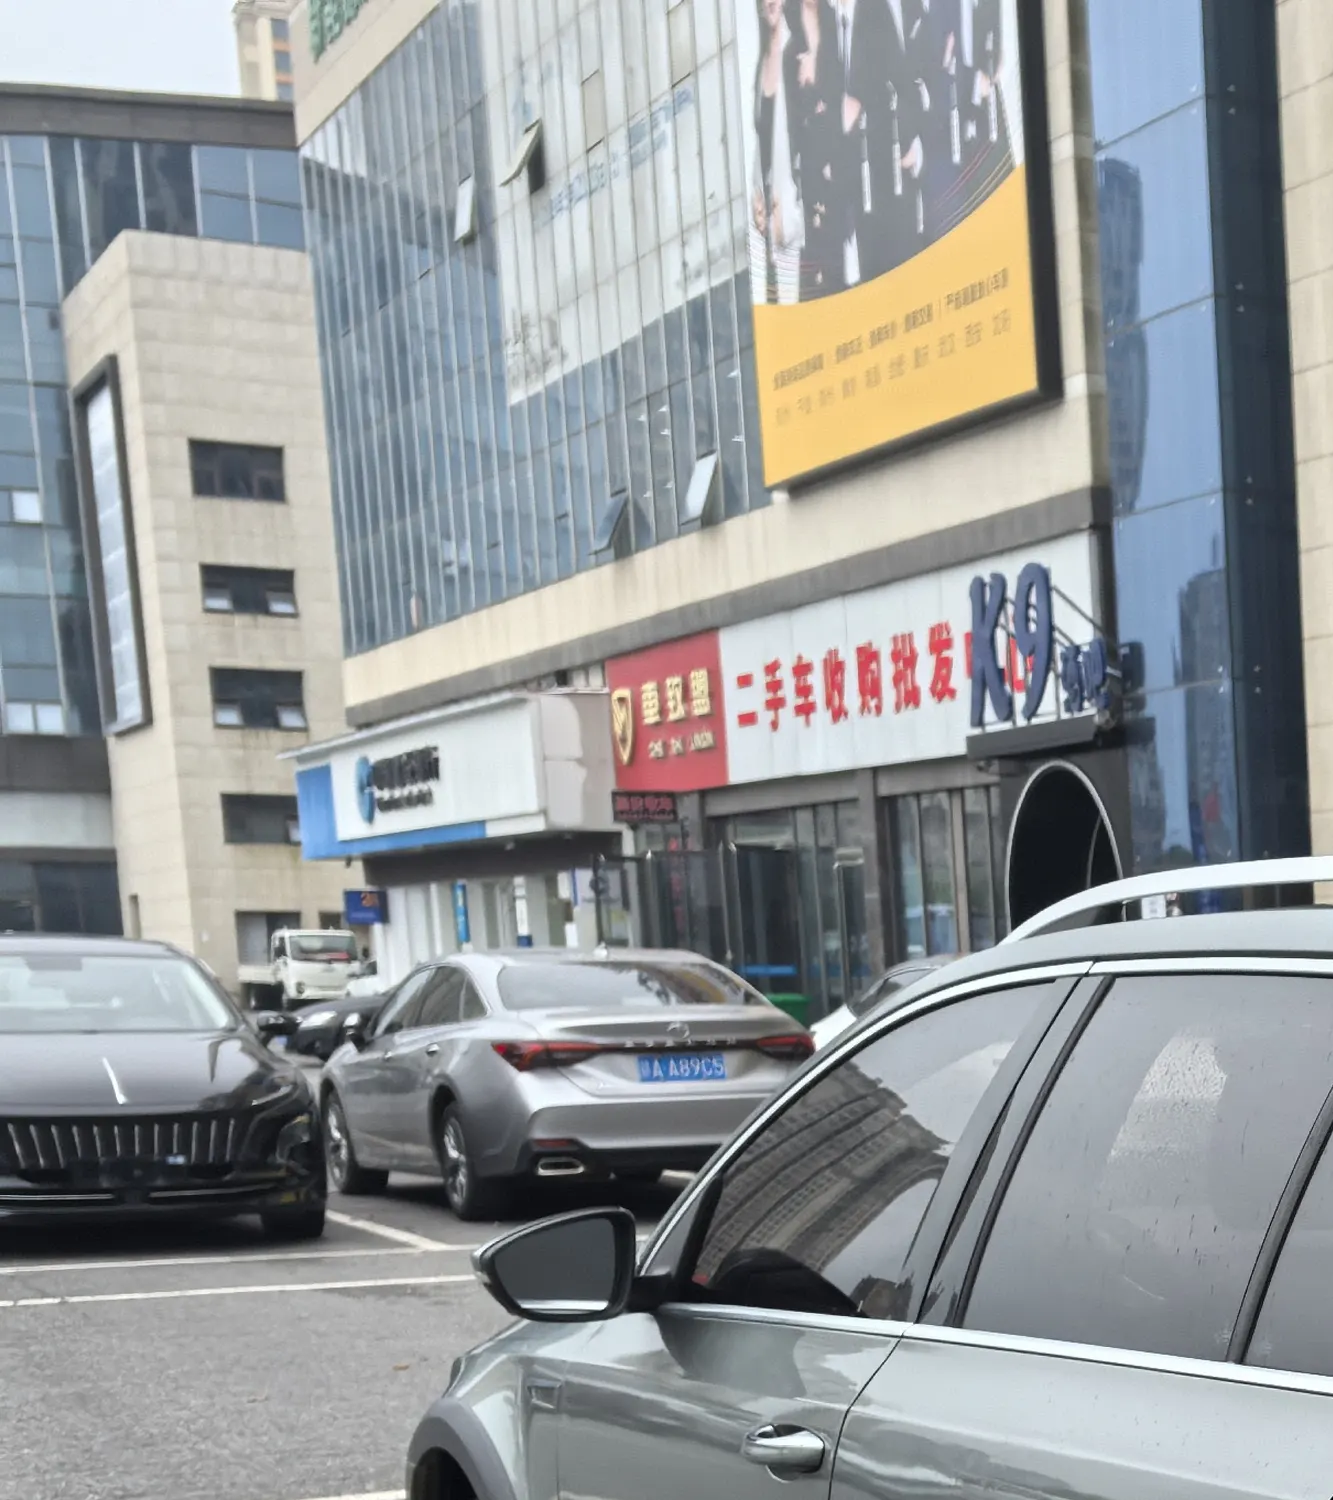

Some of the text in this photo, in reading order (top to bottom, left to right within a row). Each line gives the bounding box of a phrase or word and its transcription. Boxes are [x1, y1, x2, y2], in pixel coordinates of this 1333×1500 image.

[735, 620, 1035, 732] 二手车收购批发
[969, 562, 1052, 728] K9
